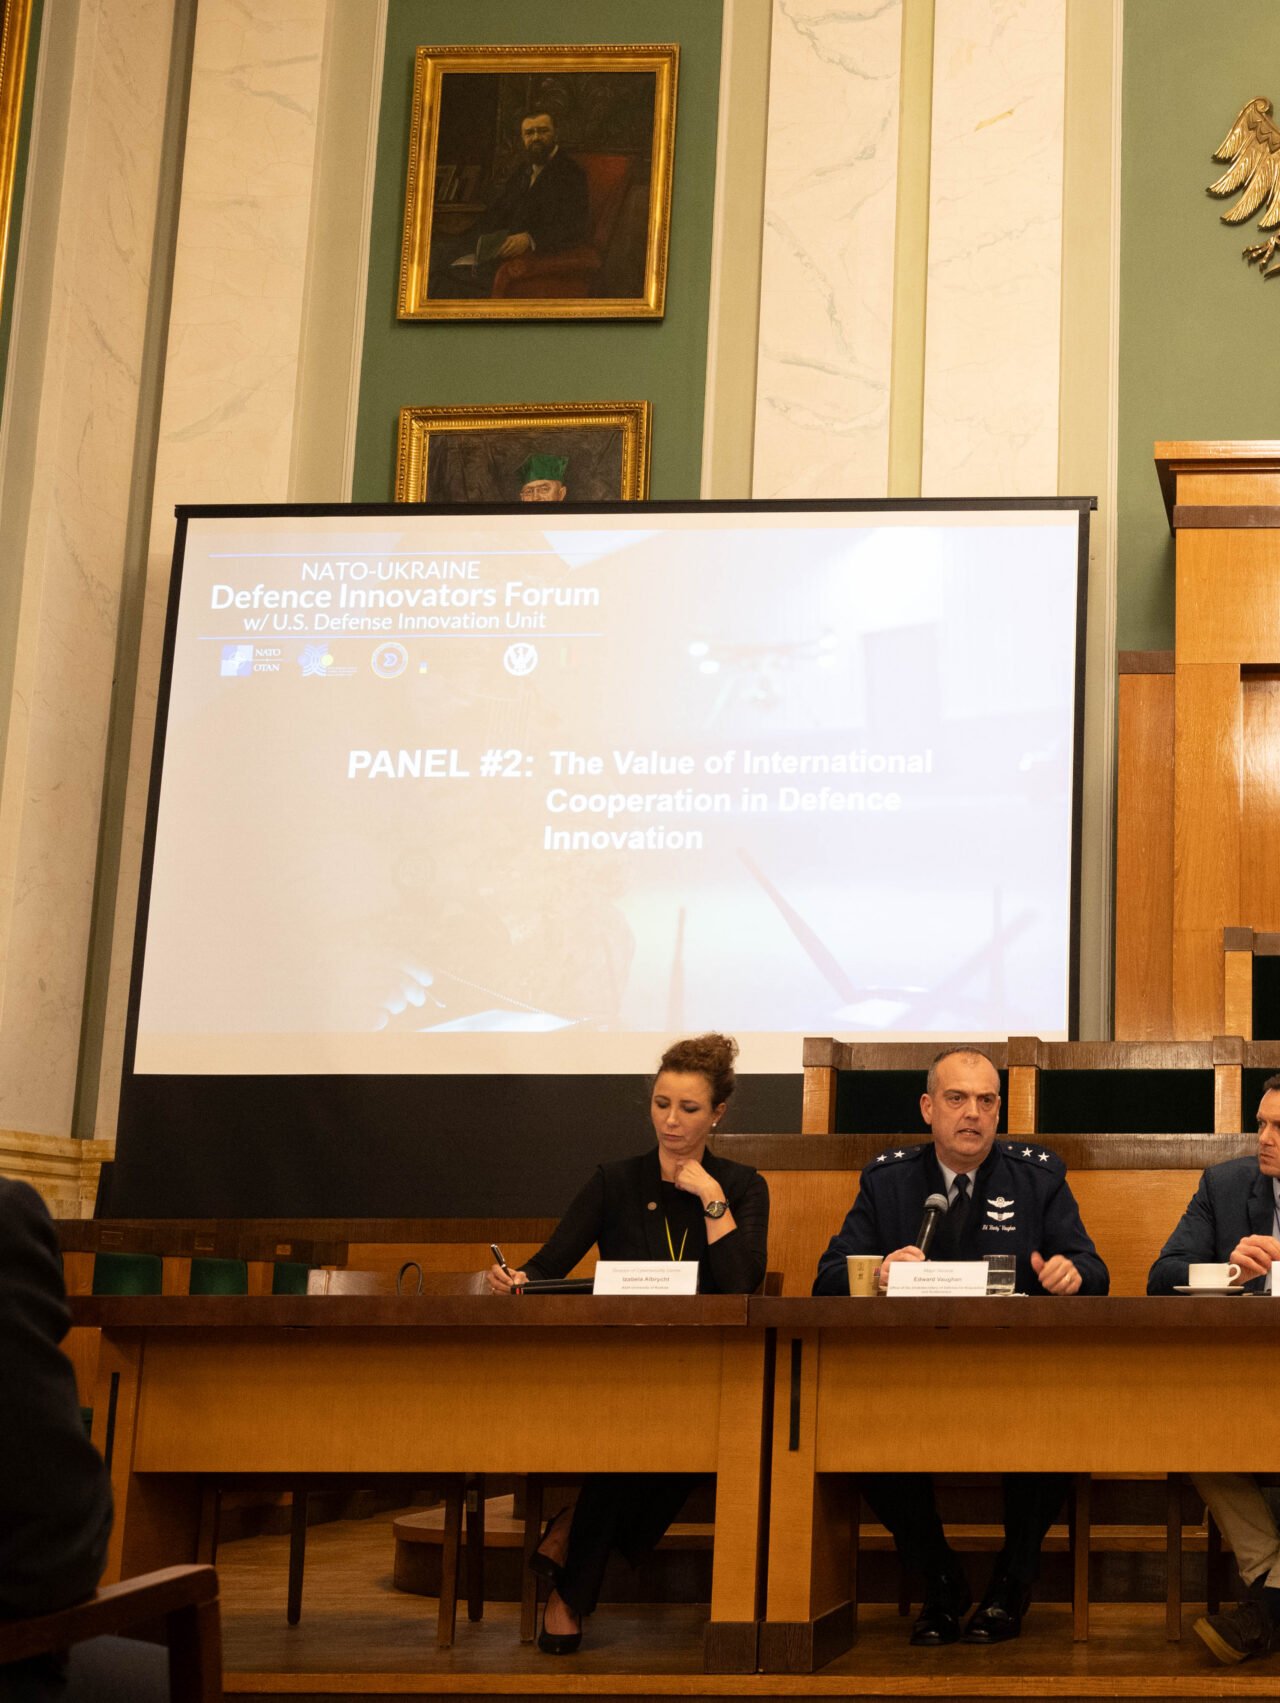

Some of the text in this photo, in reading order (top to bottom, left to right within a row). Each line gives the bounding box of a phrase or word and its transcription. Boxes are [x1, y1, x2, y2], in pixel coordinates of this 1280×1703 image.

[301, 561, 480, 581] NATO-UKRAINE
[211, 582, 600, 609] Defence Innovators Forum
[243, 612, 546, 631] w/ U.S. Defense Innovation Unit
[255, 648, 281, 657] NATO
[253, 663, 280, 672] OTAN
[348, 749, 932, 778] PANEL #2: The Value of International
[546, 788, 900, 818] Cooperation in Defence
[544, 826, 703, 850] Innovation
